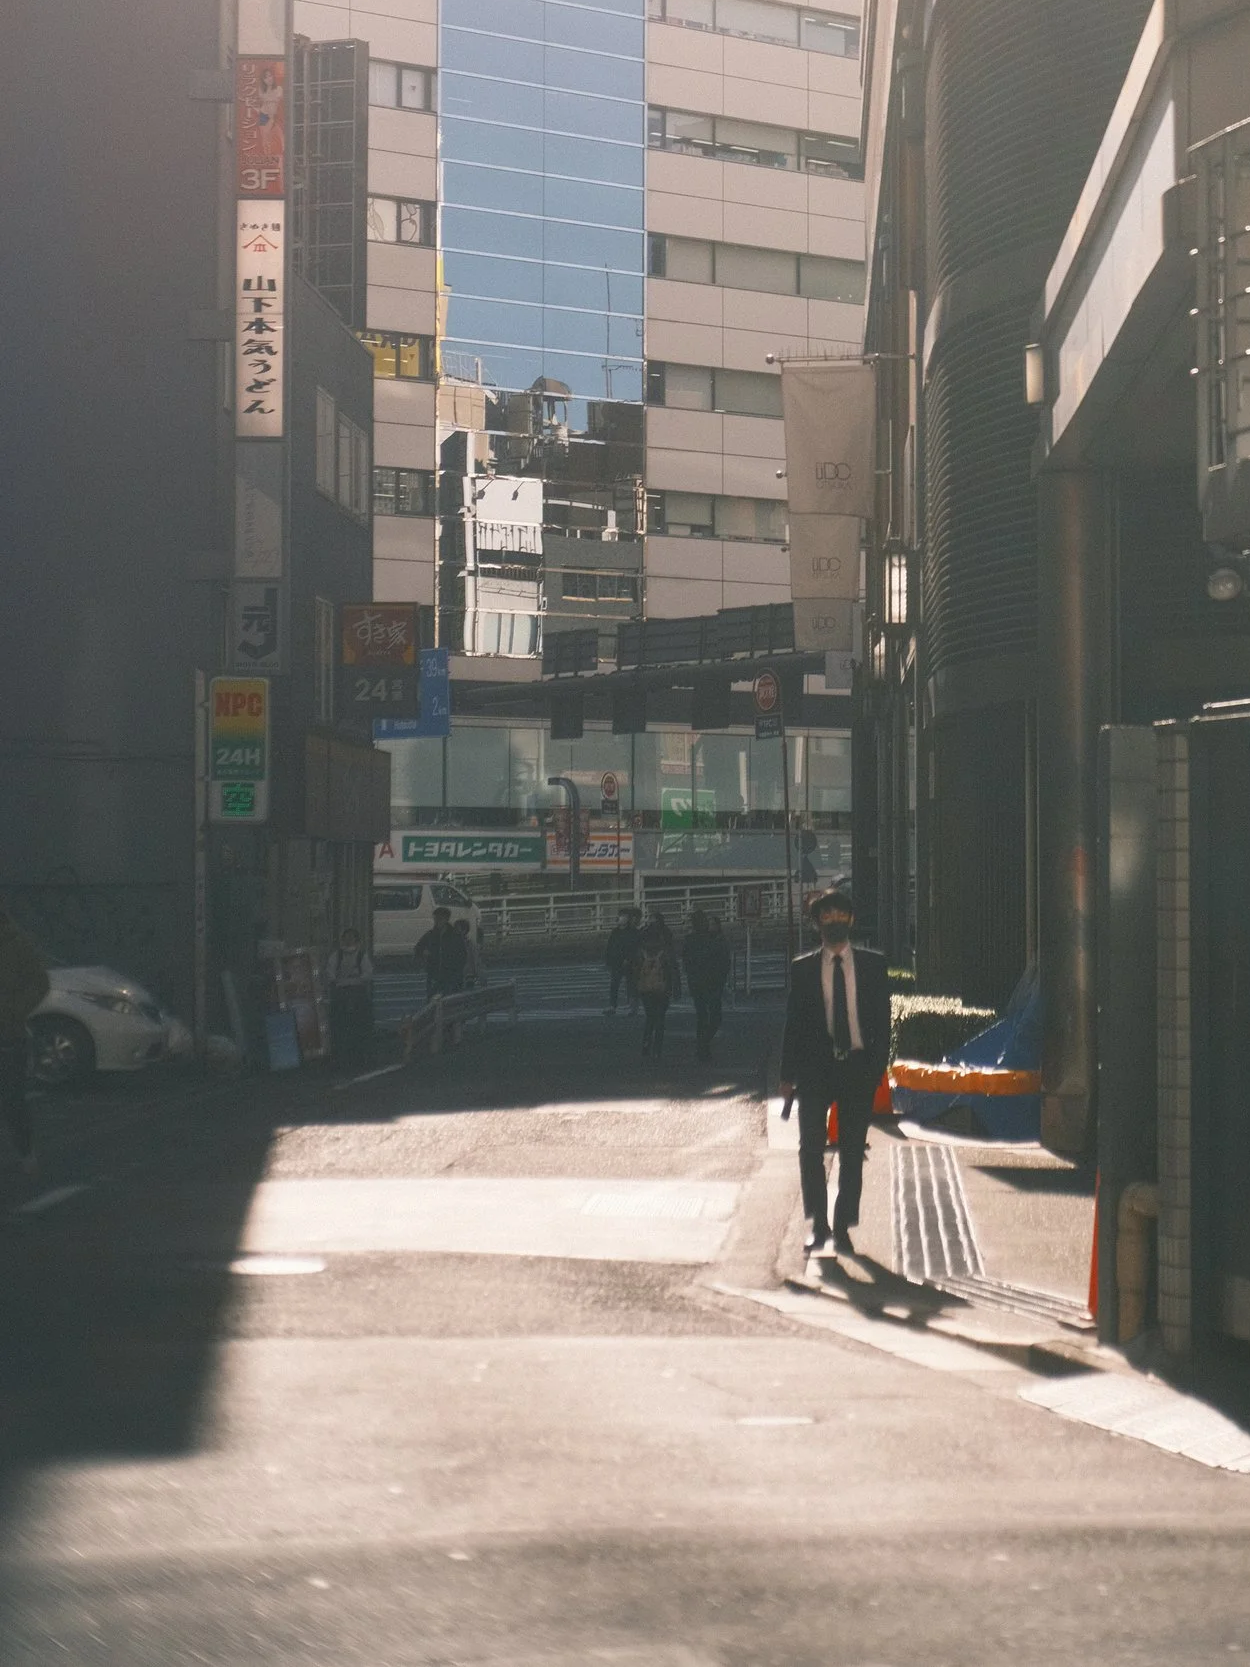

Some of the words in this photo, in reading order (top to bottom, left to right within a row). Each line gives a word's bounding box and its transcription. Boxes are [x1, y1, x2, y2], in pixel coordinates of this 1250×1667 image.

[241, 168, 280, 190] 3F
[241, 275, 279, 415] 山下本気うどん
[352, 610, 407, 650] すき家
[215, 692, 263, 717] NPC
[216, 748, 261, 765] 24H
[408, 841, 533, 858] トヨタレンタカー
